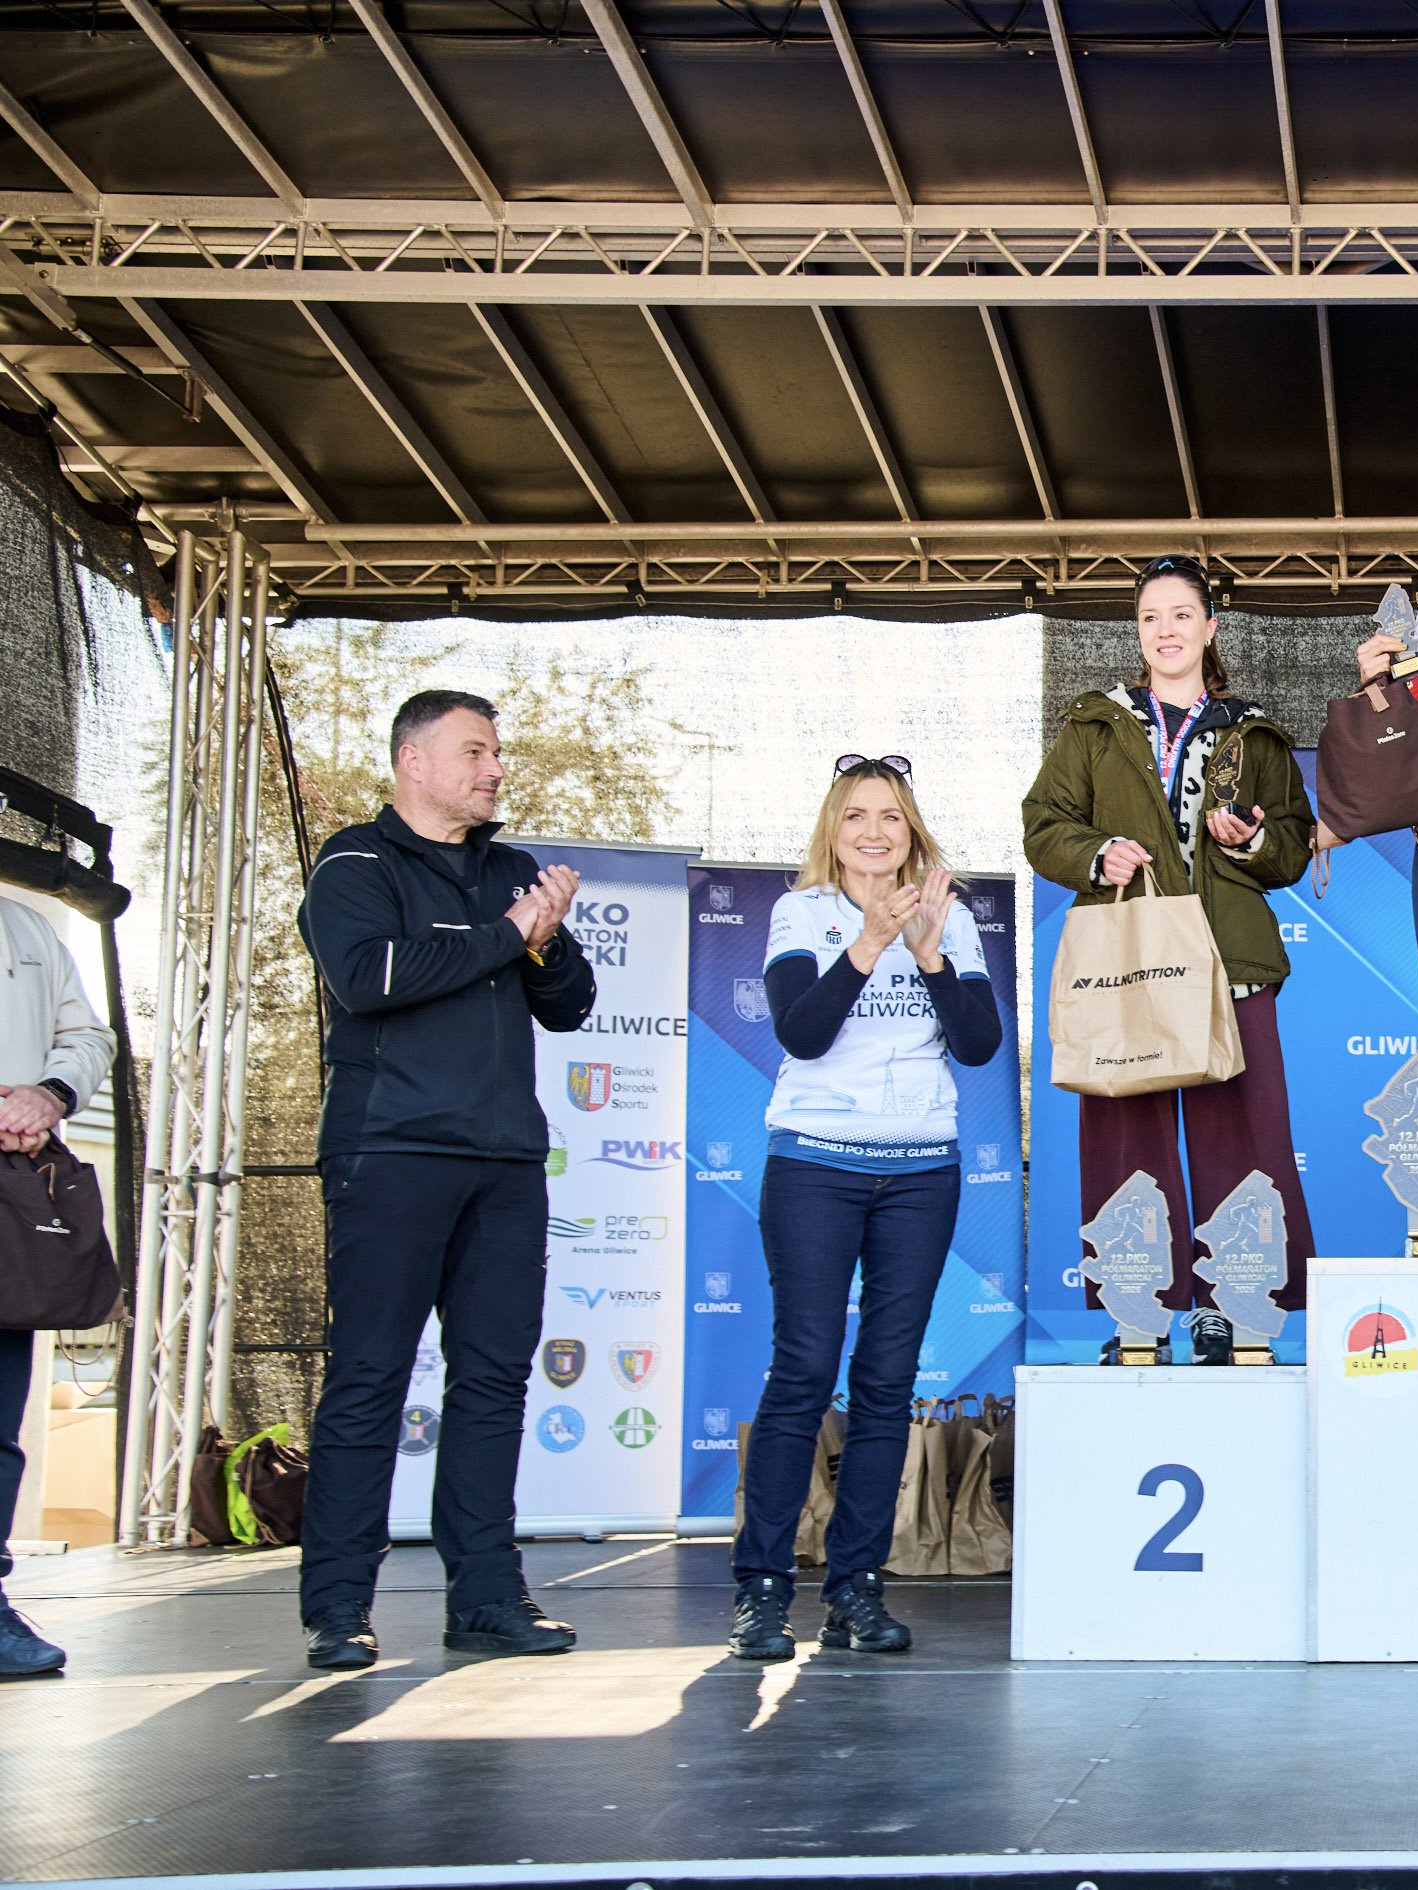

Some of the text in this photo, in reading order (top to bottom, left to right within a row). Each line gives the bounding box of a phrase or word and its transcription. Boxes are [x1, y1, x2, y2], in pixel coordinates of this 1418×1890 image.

[575, 902, 630, 925] KO
[699, 913, 744, 925] GLIWICE
[975, 923, 1005, 933] WICE
[891, 974, 924, 987] PK
[1093, 967, 1187, 989] ALLNUTRITION
[1095, 1057, 1126, 1065] Zawsze
[1137, 1051, 1163, 1062] formie!
[612, 1066, 655, 1077] Gliwicki
[612, 1081, 658, 1093] Ośrodek
[611, 1098, 648, 1110] Sportu
[601, 1139, 682, 1160] PWiK
[845, 1145, 864, 1155] PO
[865, 1148, 906, 1158] SWOJE
[907, 1145, 948, 1157] GLIWICE
[696, 1171, 742, 1181] GLIWICE
[967, 1172, 1011, 1183] GLIWICE
[605, 1216, 638, 1228] pre
[605, 1230, 650, 1240] zero
[609, 1290, 662, 1301] VENTUS
[694, 1303, 742, 1313] GLIWICE
[970, 1302, 1015, 1313] GLIWICE
[1352, 1361, 1408, 1370] GLIWICE
[410, 1411, 421, 1422] 4
[692, 1440, 740, 1450] GLIWICE
[1134, 1463, 1205, 1572] 2
